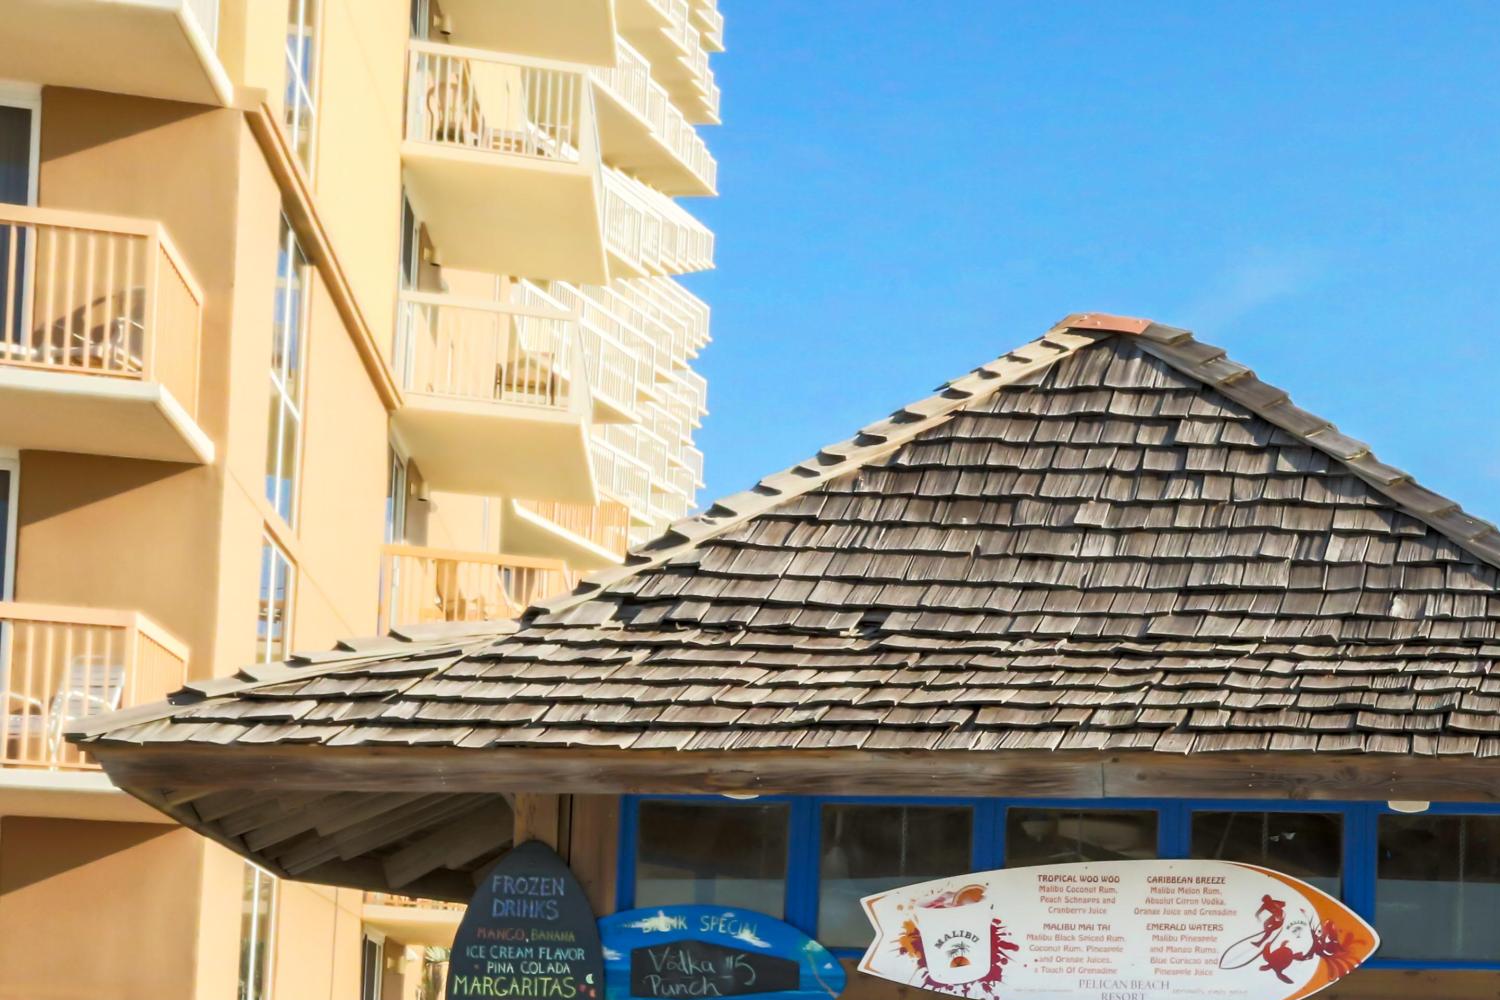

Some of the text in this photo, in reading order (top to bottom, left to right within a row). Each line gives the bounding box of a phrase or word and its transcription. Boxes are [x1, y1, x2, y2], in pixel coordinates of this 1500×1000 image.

[1038, 874, 1121, 884] TROPICAL WOO WOO
[1146, 876, 1226, 885] CARIBBEAN BREEZE
[491, 875, 565, 896] FROZEN
[1039, 885, 1064, 893] Malibu
[1065, 885, 1097, 893] Coconut
[1150, 886, 1176, 894] Malibu
[1177, 887, 1201, 895] Melon
[1040, 895, 1117, 905] Peach Schnapps and
[1145, 897, 1174, 905] Absolut
[1175, 897, 1199, 905] Citron
[491, 898, 559, 920] DRINKS
[1048, 906, 1108, 915] Cranberry Juice
[1134, 907, 1238, 916] Orange Juice and Grenadine
[1043, 923, 1111, 931] MALIBU MAI TAI
[1146, 923, 1224, 931] EMERALD WATERS
[530, 928, 576, 942] BANANA
[934, 929, 980, 949] MALIBU
[1026, 933, 1053, 941] Malibu
[1054, 934, 1077, 942] Black
[1151, 934, 1218, 942] Malibu Pineapple
[465, 945, 585, 960] ICE CREAM FLAVOR
[1029, 944, 1061, 952] Coconut
[1086, 945, 1124, 953] Pineapple
[1150, 945, 1164, 953] and
[1166, 945, 1193, 953] Mango
[1038, 955, 1054, 963] and
[1055, 955, 1084, 963] Orange
[1150, 956, 1168, 964] Blue
[1204, 957, 1219, 965] and
[487, 961, 571, 975] PINA COLADA
[1040, 966, 1065, 974] Touch
[1078, 966, 1118, 974] Grenadine
[1154, 967, 1214, 976] Pineapple Juice
[453, 974, 577, 999] MARGARITAS
[643, 973, 723, 997] Punch
[1079, 979, 1170, 991] PELICAN BEACH
